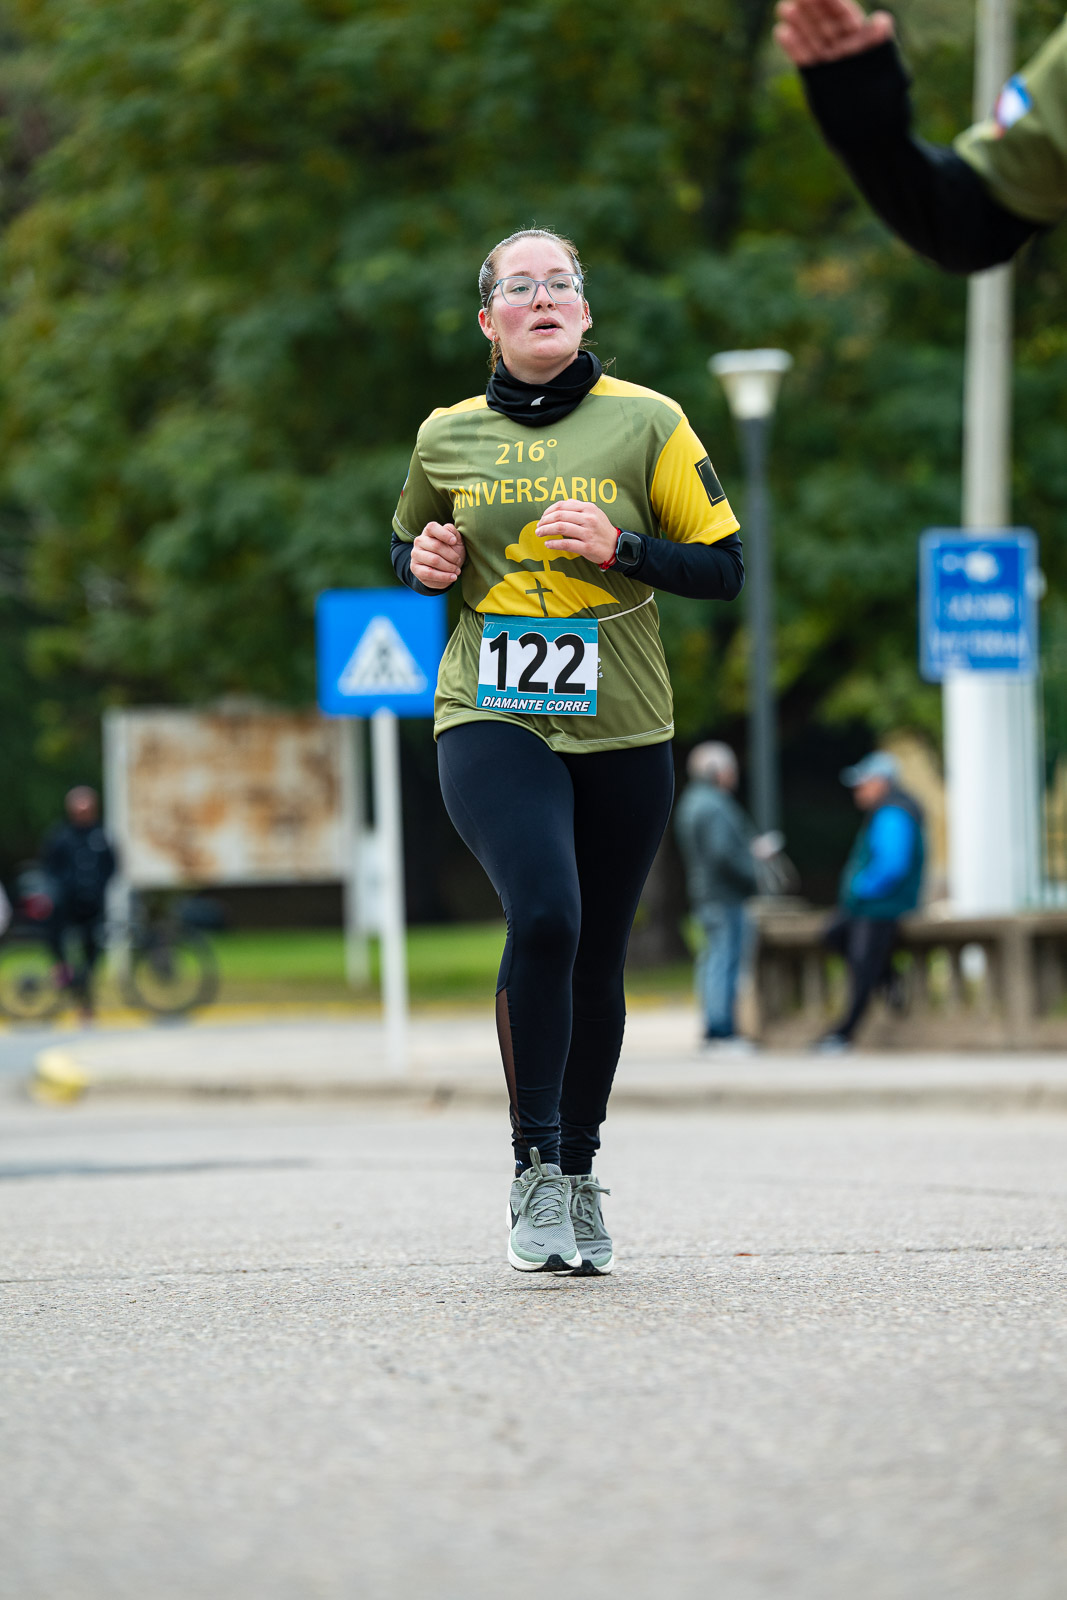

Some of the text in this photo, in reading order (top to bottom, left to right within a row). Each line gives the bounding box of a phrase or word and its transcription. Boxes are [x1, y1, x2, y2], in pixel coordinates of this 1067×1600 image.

[495, 438, 558, 466] 216°
[451, 476, 618, 511] ANIVERSARIO
[489, 631, 586, 695] 122
[481, 696, 591, 713] DIAMANTE CORRE
